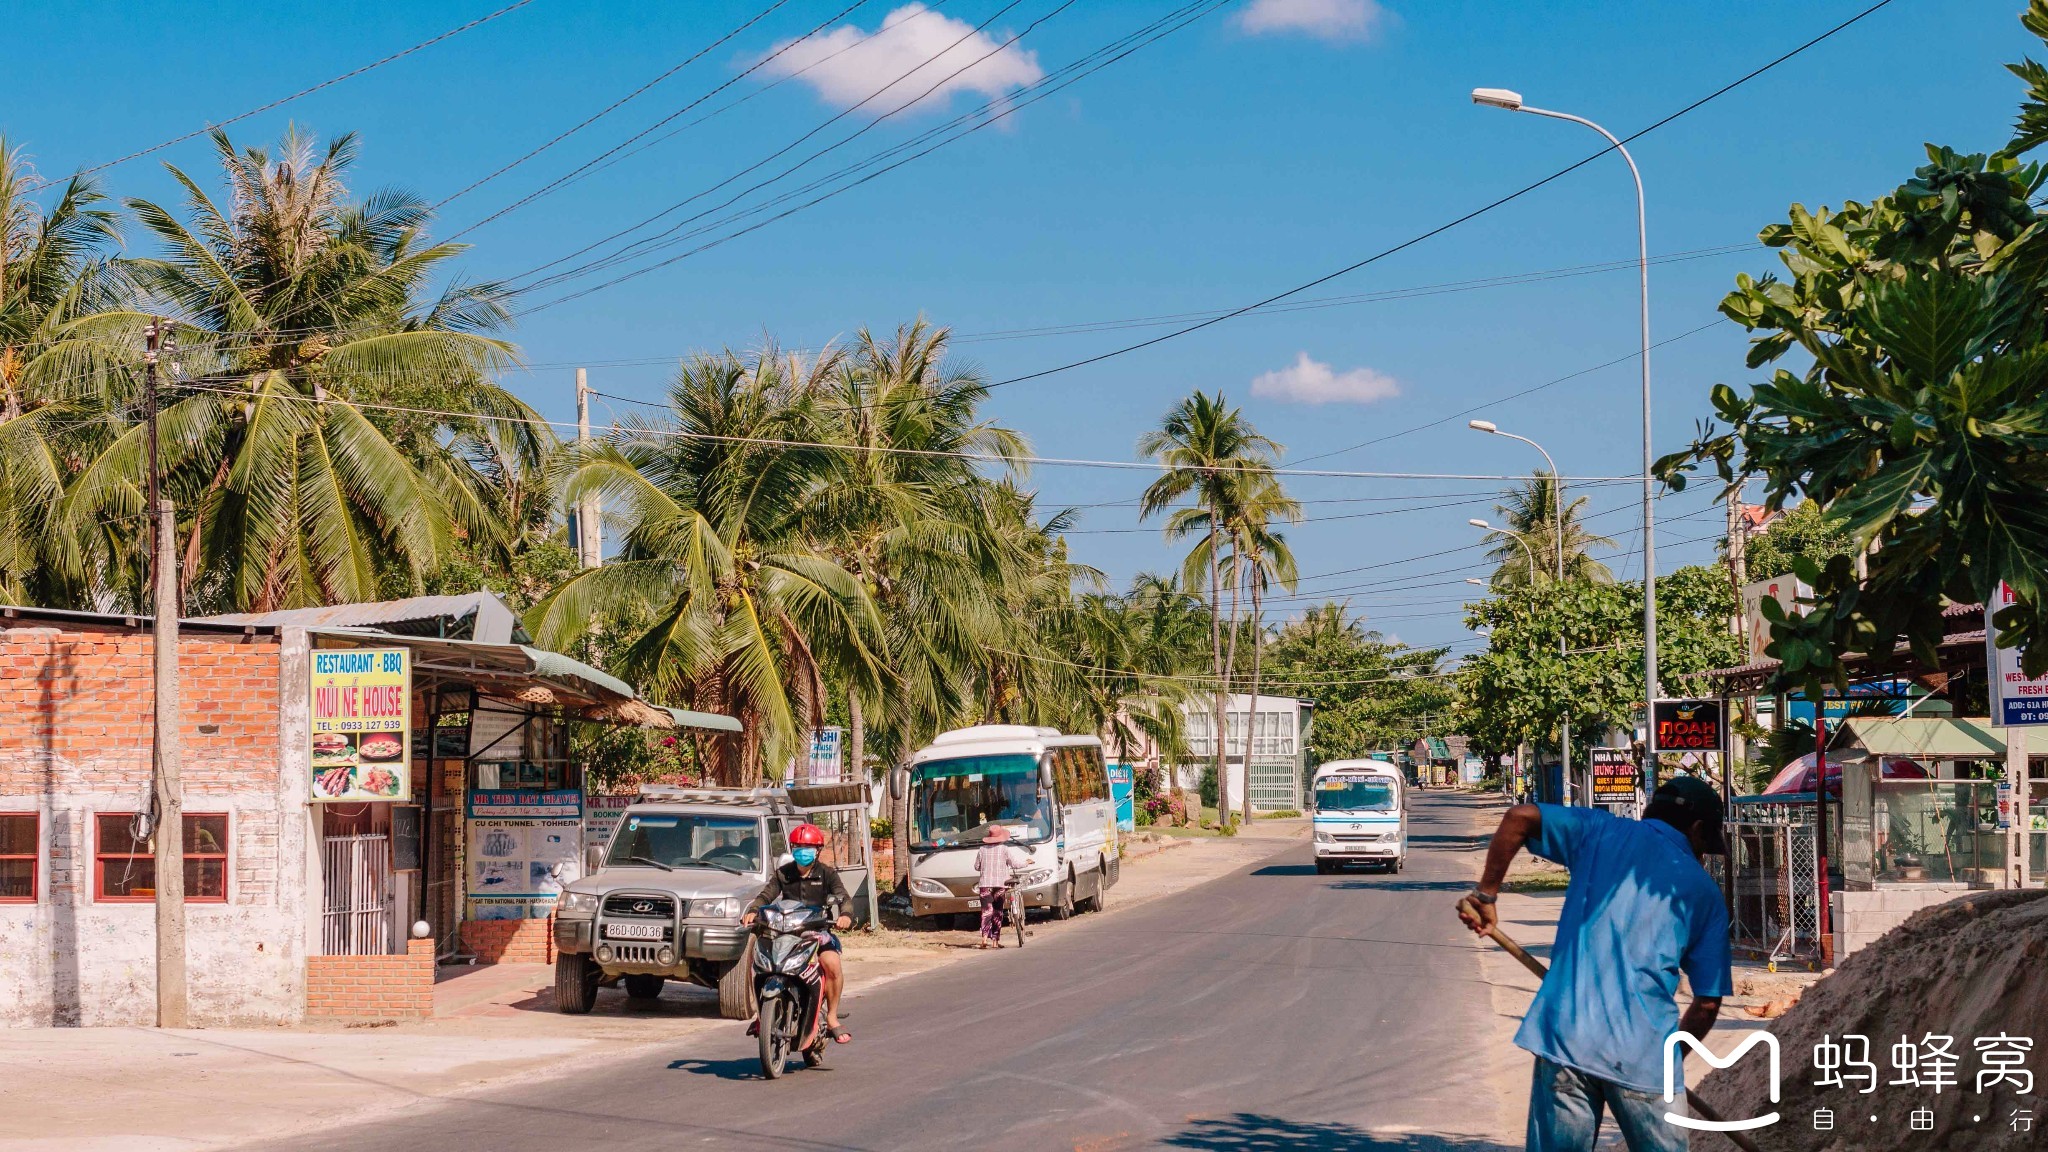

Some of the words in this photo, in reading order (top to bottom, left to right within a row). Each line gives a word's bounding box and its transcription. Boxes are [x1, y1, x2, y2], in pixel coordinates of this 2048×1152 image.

[316, 653, 374, 674] RESTAURANT
[383, 653, 402, 675] BBQ
[2018, 686, 2042, 695] FRESH
[362, 685, 403, 718] HOUSE
[2008, 701, 2025, 710] ADD:
[2026, 701, 2041, 709] 61A
[316, 722, 332, 731] TEL
[341, 721, 363, 730] 0933
[366, 721, 381, 730] 127
[384, 720, 401, 729] 939
[1659, 721, 1716, 735] ЛОАН
[1659, 735, 1716, 748] КАФЕ
[1594, 752, 1611, 762] NHÀ
[1596, 777, 1613, 785] GUEST
[1614, 777, 1632, 785] HOUSE
[474, 794, 488, 804] MR
[519, 794, 539, 804] DAT
[542, 794, 580, 804] TRAVEL
[607, 797, 630, 809] TIEN
